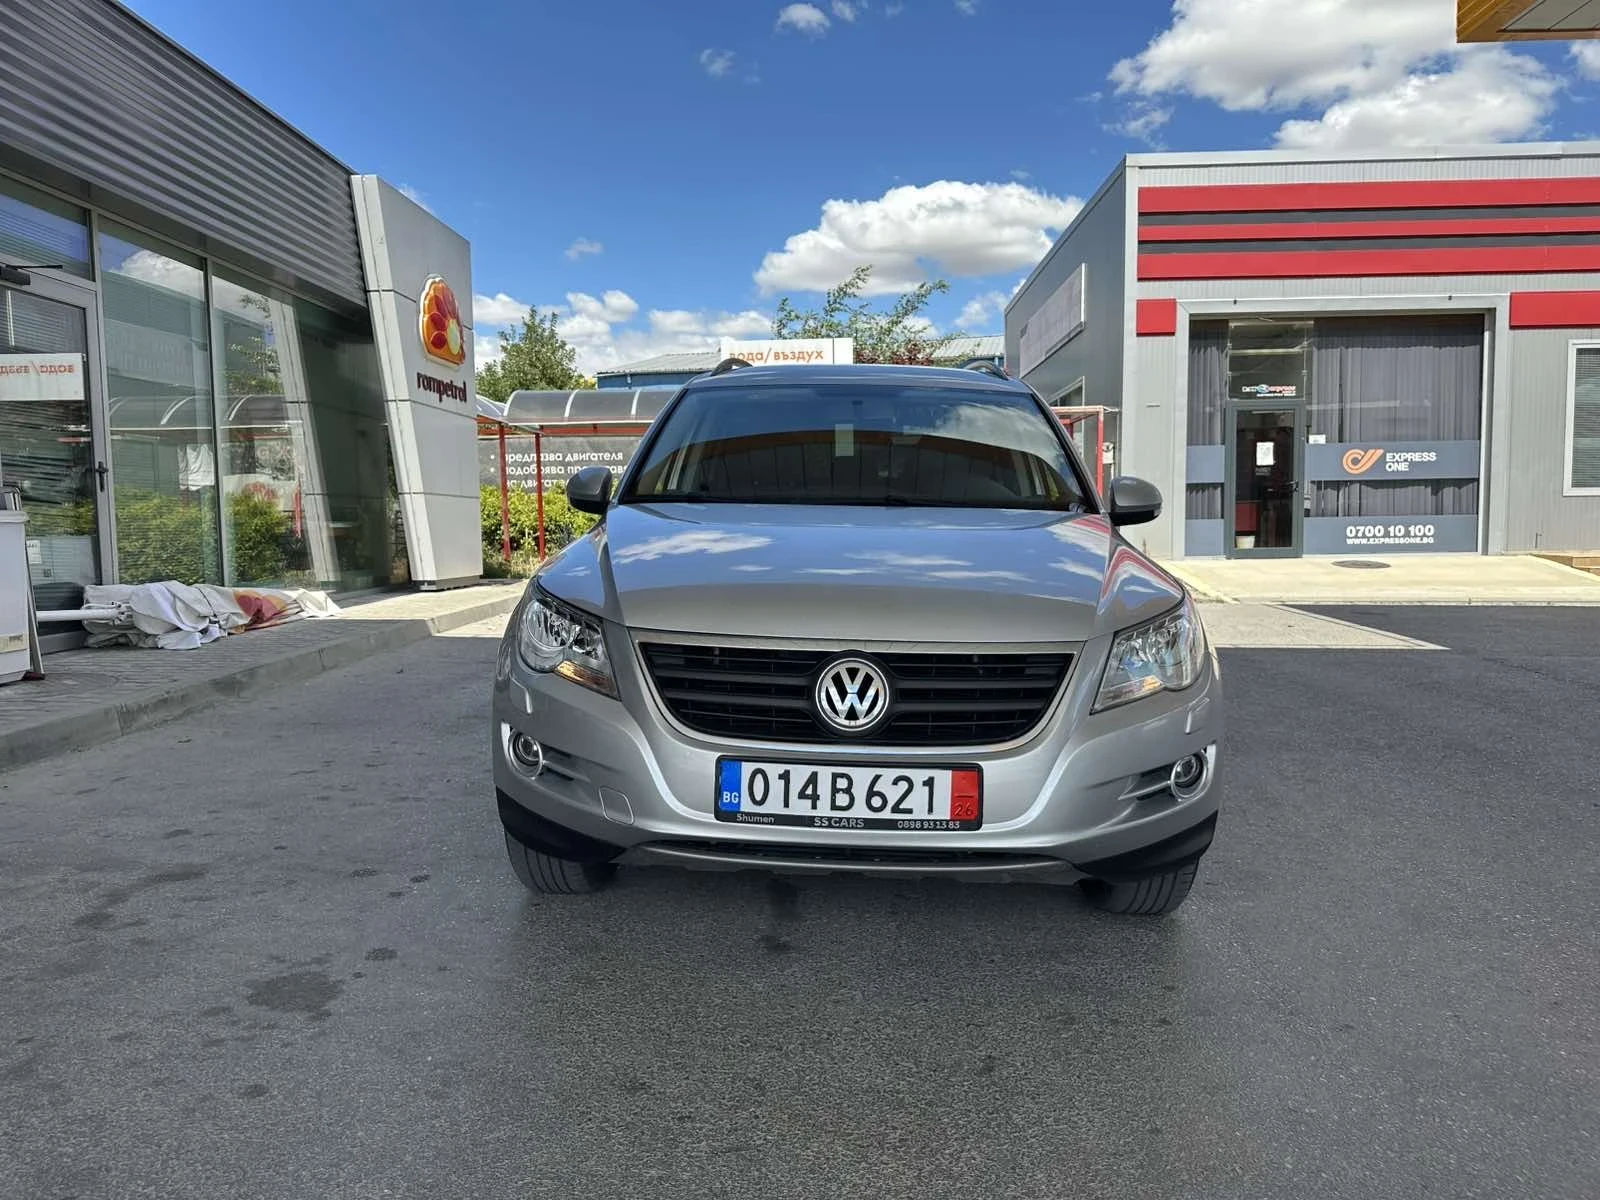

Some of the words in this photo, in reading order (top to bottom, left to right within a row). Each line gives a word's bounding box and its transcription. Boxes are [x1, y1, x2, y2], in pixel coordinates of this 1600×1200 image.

[416, 371, 468, 403] rompetrol
[565, 451, 623, 463] двигателя
[1385, 452, 1437, 462] EXPRESS
[1385, 462, 1409, 472] ONE
[1346, 525, 1385, 537] 0700
[1387, 525, 1405, 537] 10
[1408, 524, 1435, 537] 100
[723, 791, 739, 804] BG
[953, 801, 974, 817] 26
[736, 813, 775, 824] Shumen
[814, 817, 829, 827] SS
[830, 817, 865, 828] CARS
